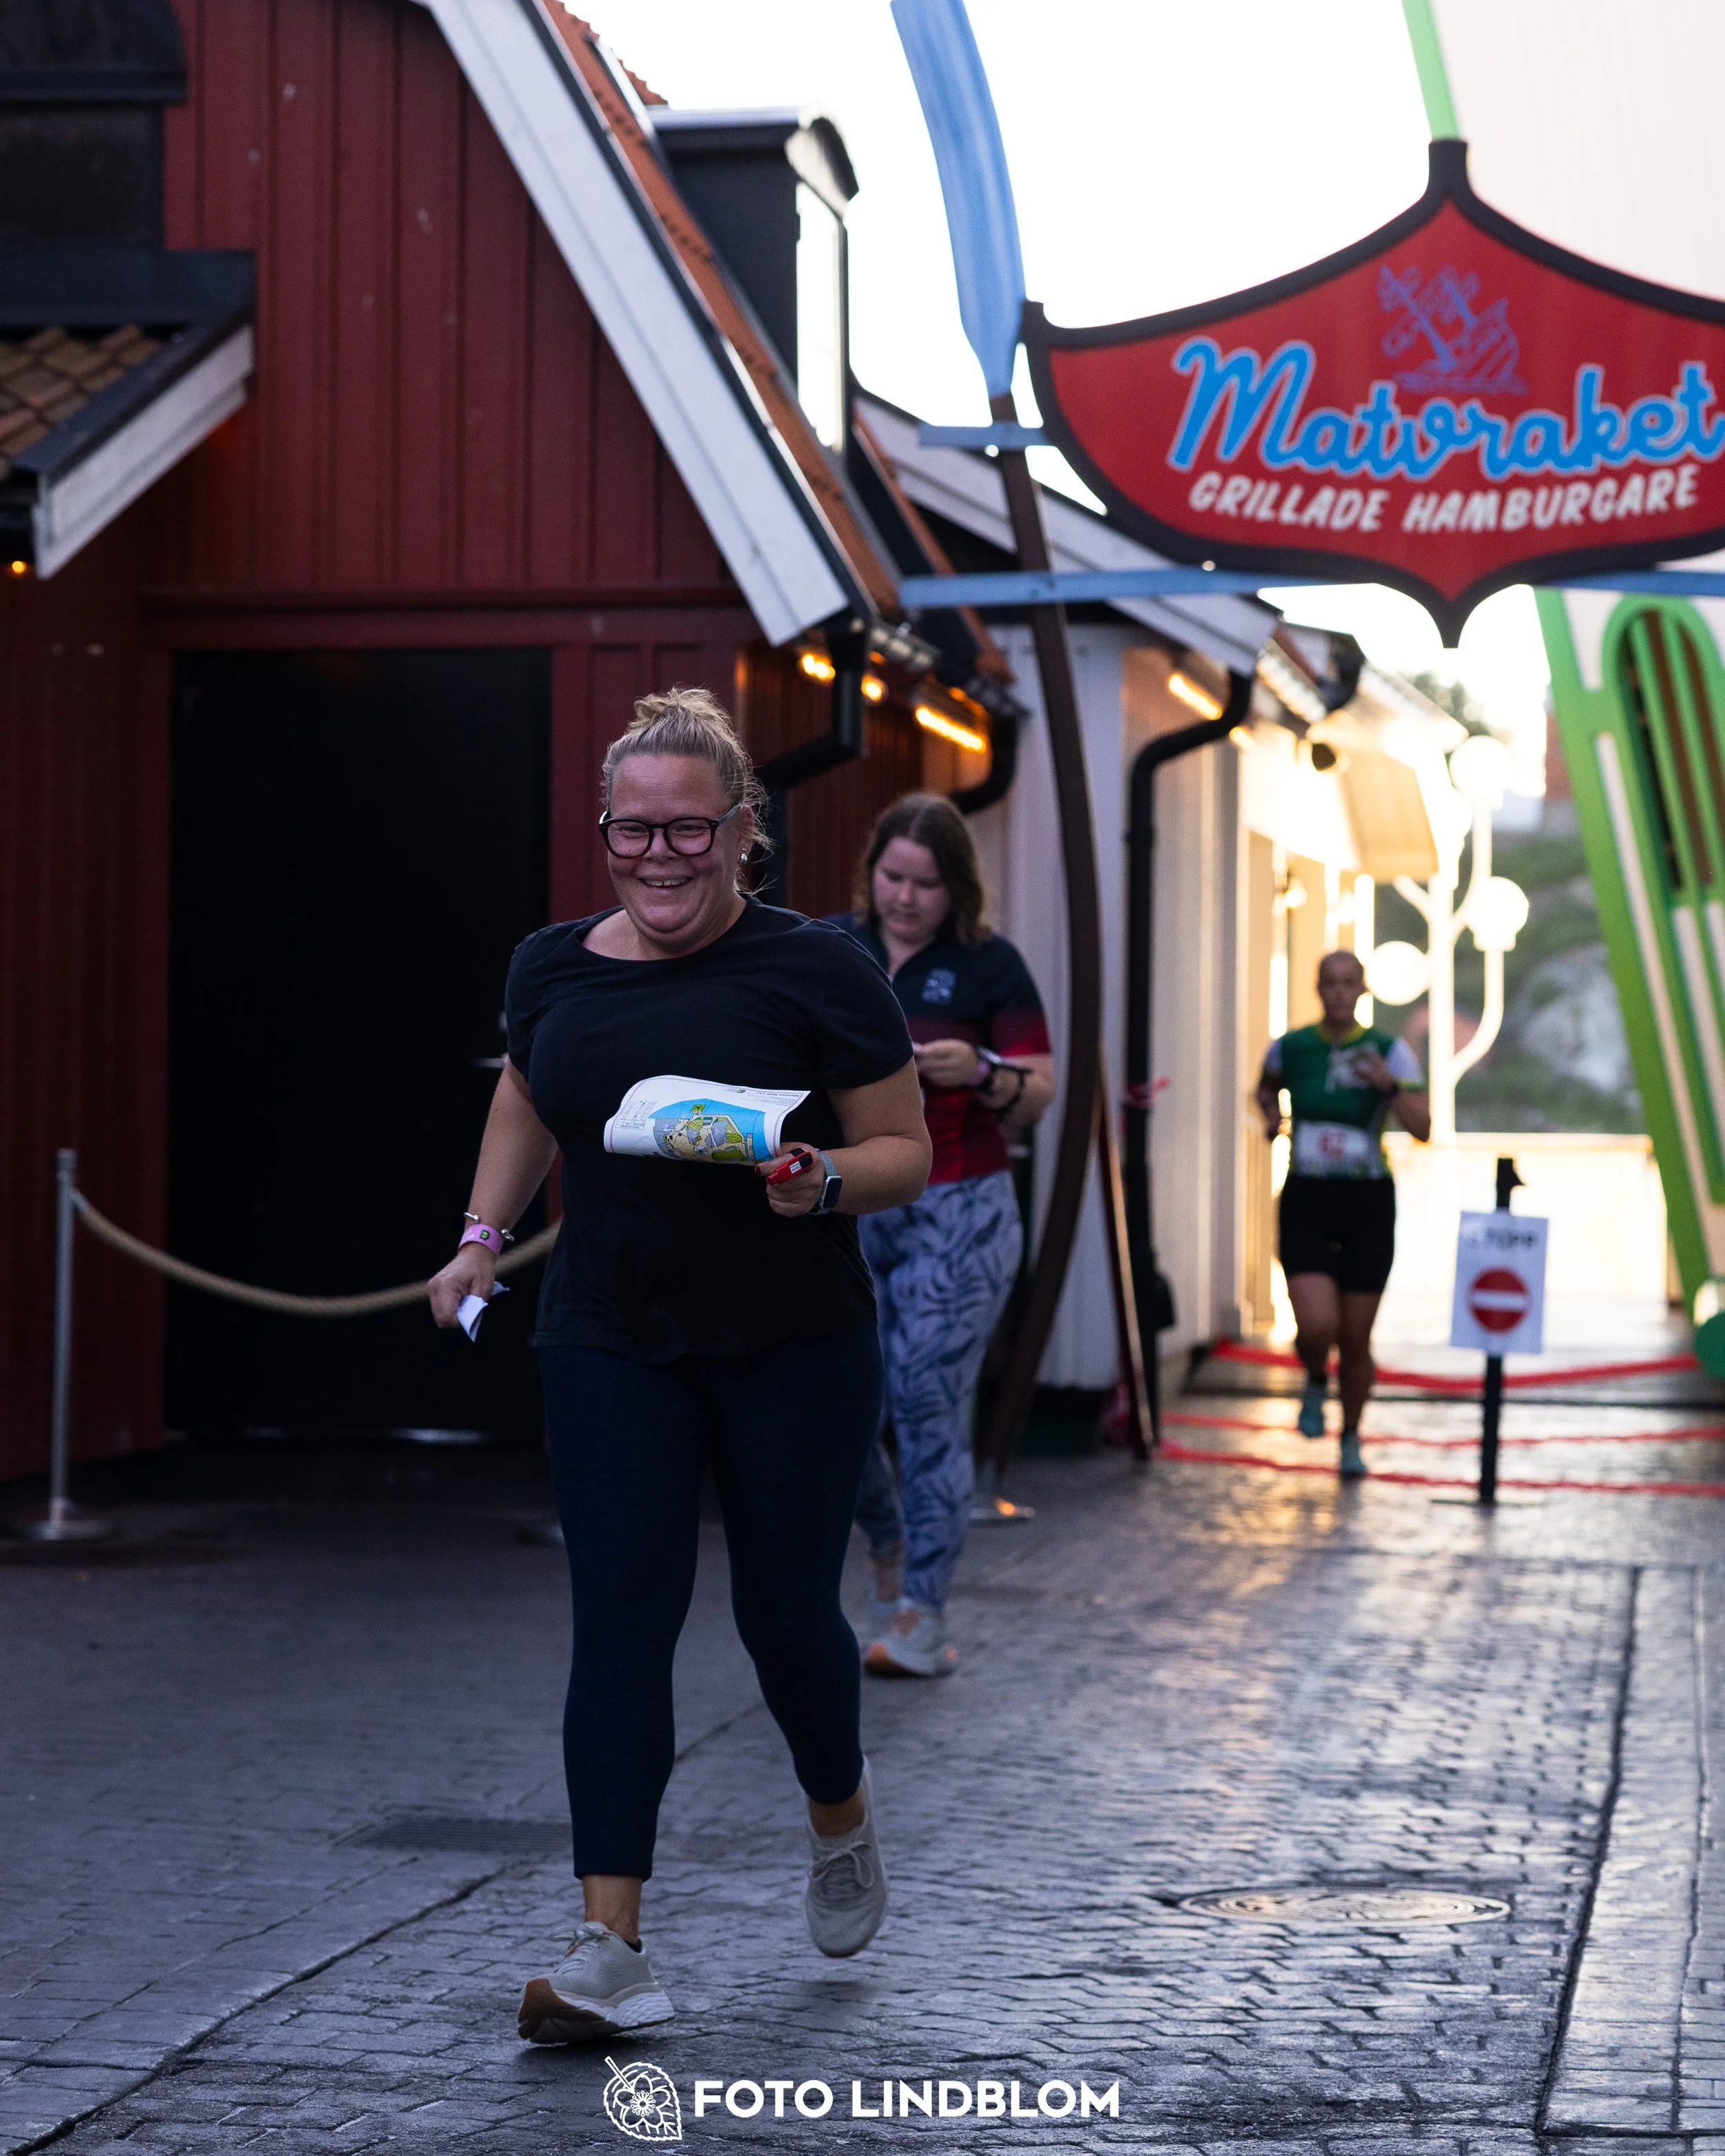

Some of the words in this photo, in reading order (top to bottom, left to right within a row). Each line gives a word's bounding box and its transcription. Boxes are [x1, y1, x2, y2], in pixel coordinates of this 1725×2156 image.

[1169, 337, 1725, 482] Matvraket
[1189, 471, 1389, 533] GRILLADE
[1401, 463, 1699, 533] HAMBURGARE
